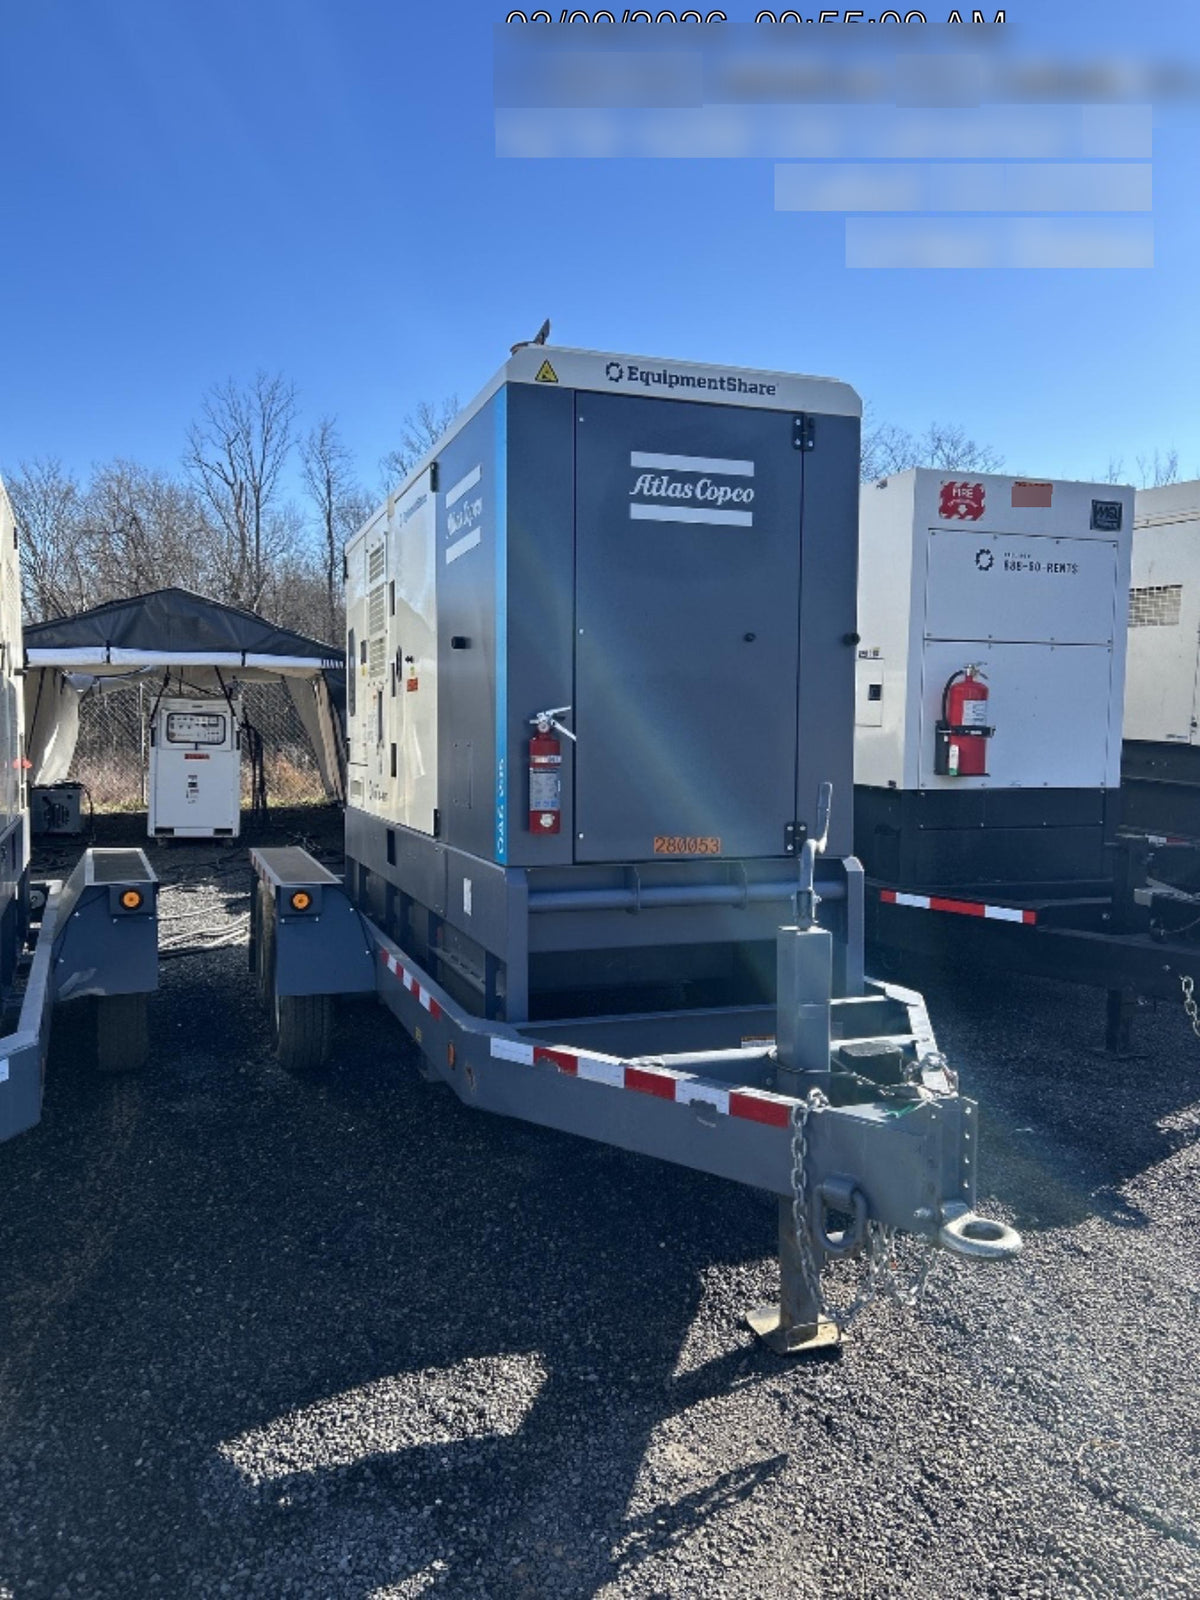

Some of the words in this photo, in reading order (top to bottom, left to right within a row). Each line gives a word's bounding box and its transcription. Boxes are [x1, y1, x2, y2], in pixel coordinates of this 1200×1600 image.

[627, 365, 776, 396] EquipmentShare
[629, 473, 693, 499] Atlas
[695, 477, 755, 506] Copco
